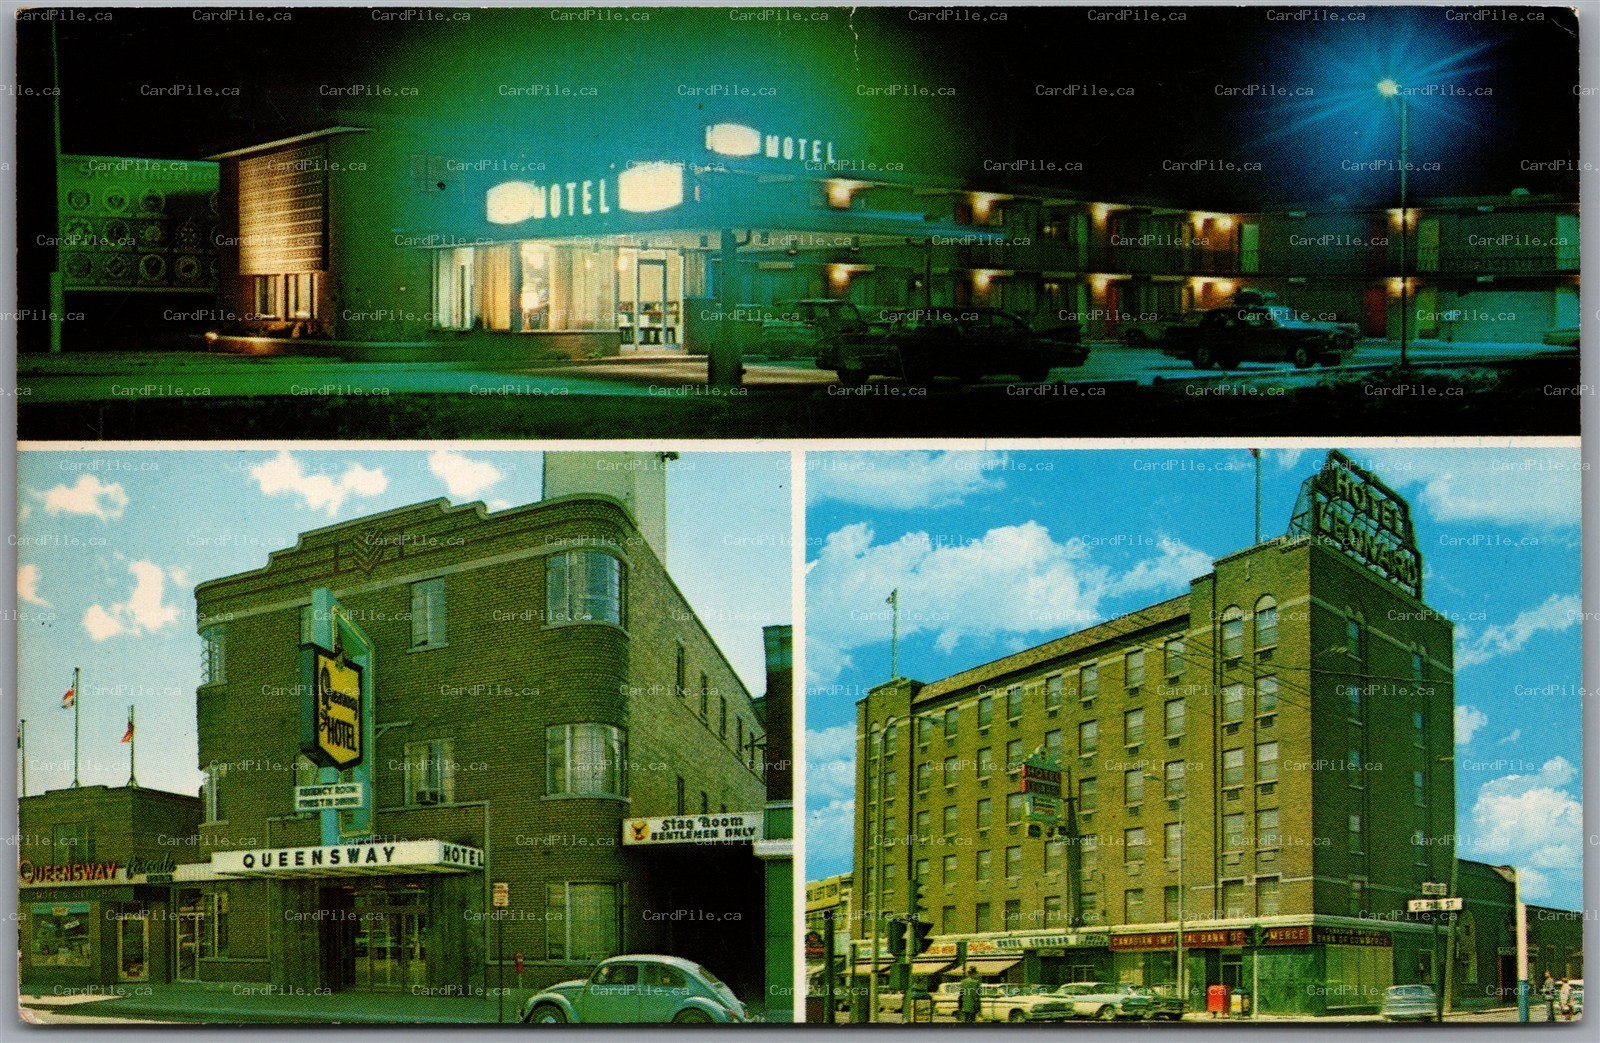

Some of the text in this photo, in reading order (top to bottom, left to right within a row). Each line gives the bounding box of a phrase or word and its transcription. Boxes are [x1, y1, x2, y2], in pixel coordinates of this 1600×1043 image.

[766, 135, 835, 163] MOTEL
[532, 179, 610, 219] MOTEL
[1334, 466, 1405, 540] HOTEL
[1317, 499, 1418, 585] LEONARD
[327, 716, 357, 752] HOTEL
[651, 827, 756, 841] GENTLEMEN ONLY
[661, 815, 744, 832] Stag Room
[243, 846, 395, 868] QUEENSWAY
[443, 845, 485, 867] HOTEL
[20, 859, 117, 884] QUEENSWAY
[1157, 933, 1197, 945] IMPIAL
[1201, 931, 1225, 943] BANK
[1230, 932, 1242, 943] OF
